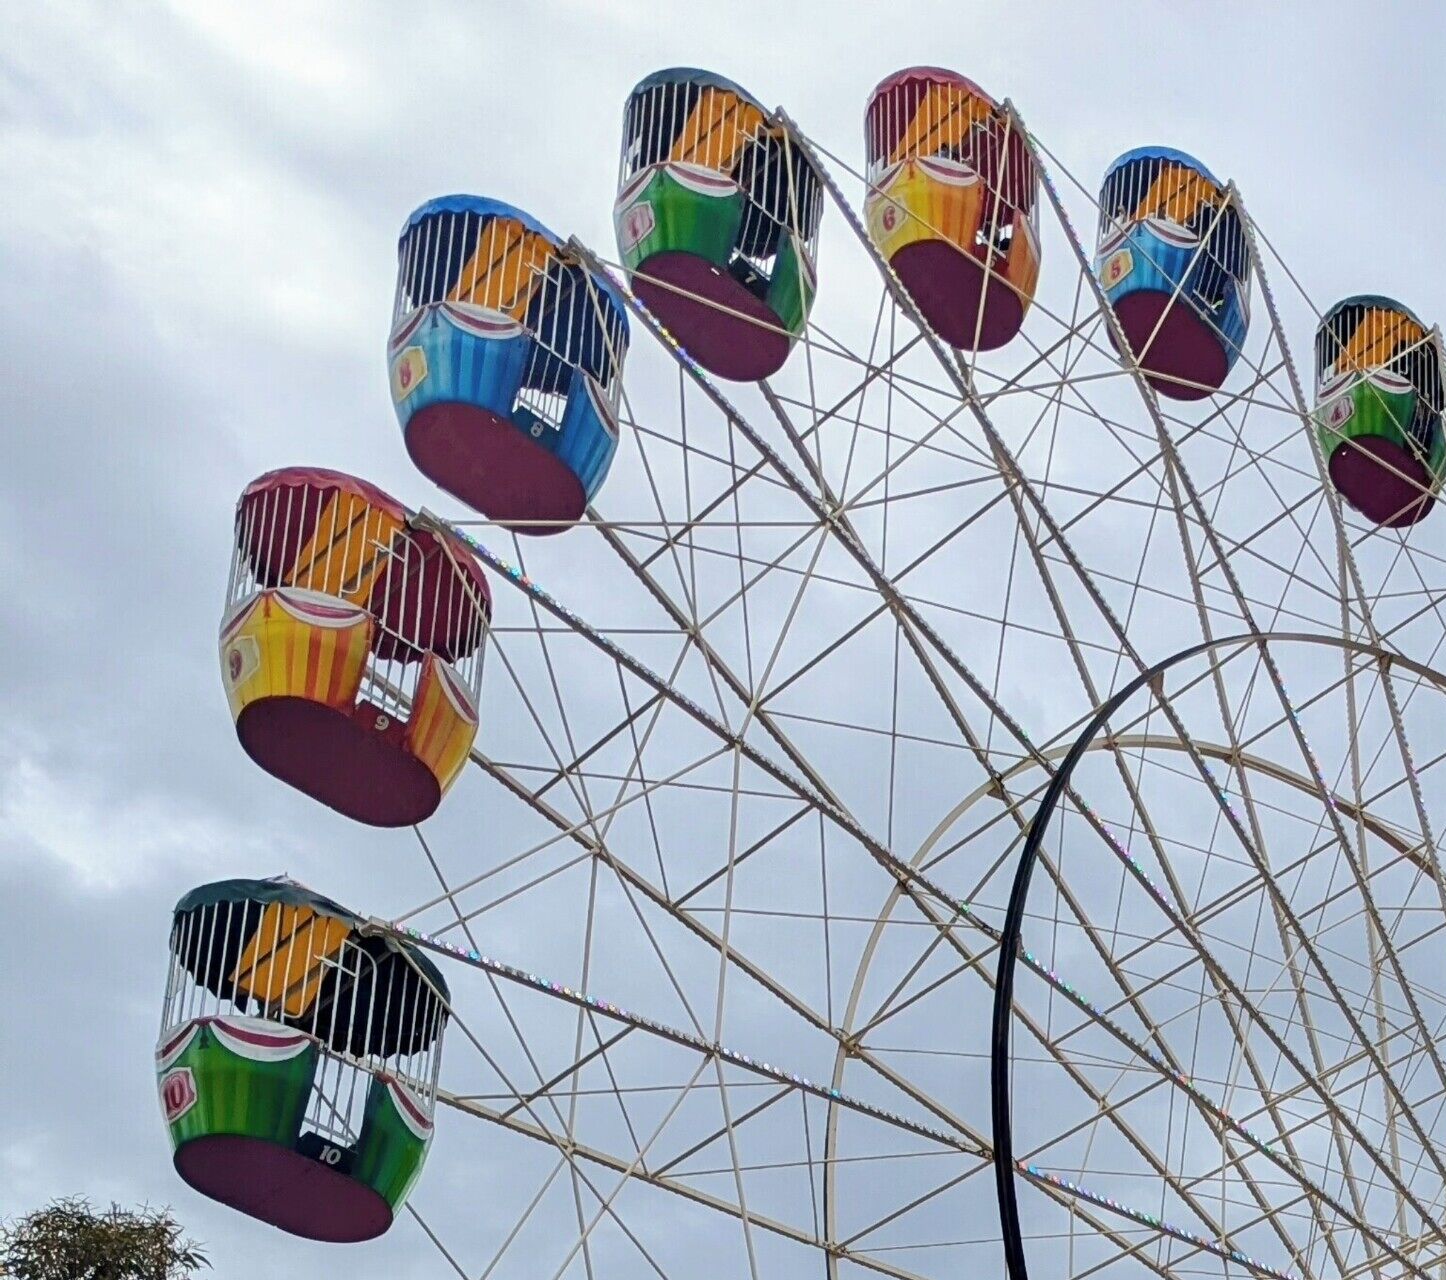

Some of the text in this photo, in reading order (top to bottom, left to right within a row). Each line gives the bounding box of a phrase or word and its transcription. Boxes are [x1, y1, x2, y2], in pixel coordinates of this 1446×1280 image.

[883, 205, 895, 231] 6
[531, 421, 545, 437] 8
[375, 714, 389, 731] 9
[319, 1144, 341, 1165] 10
